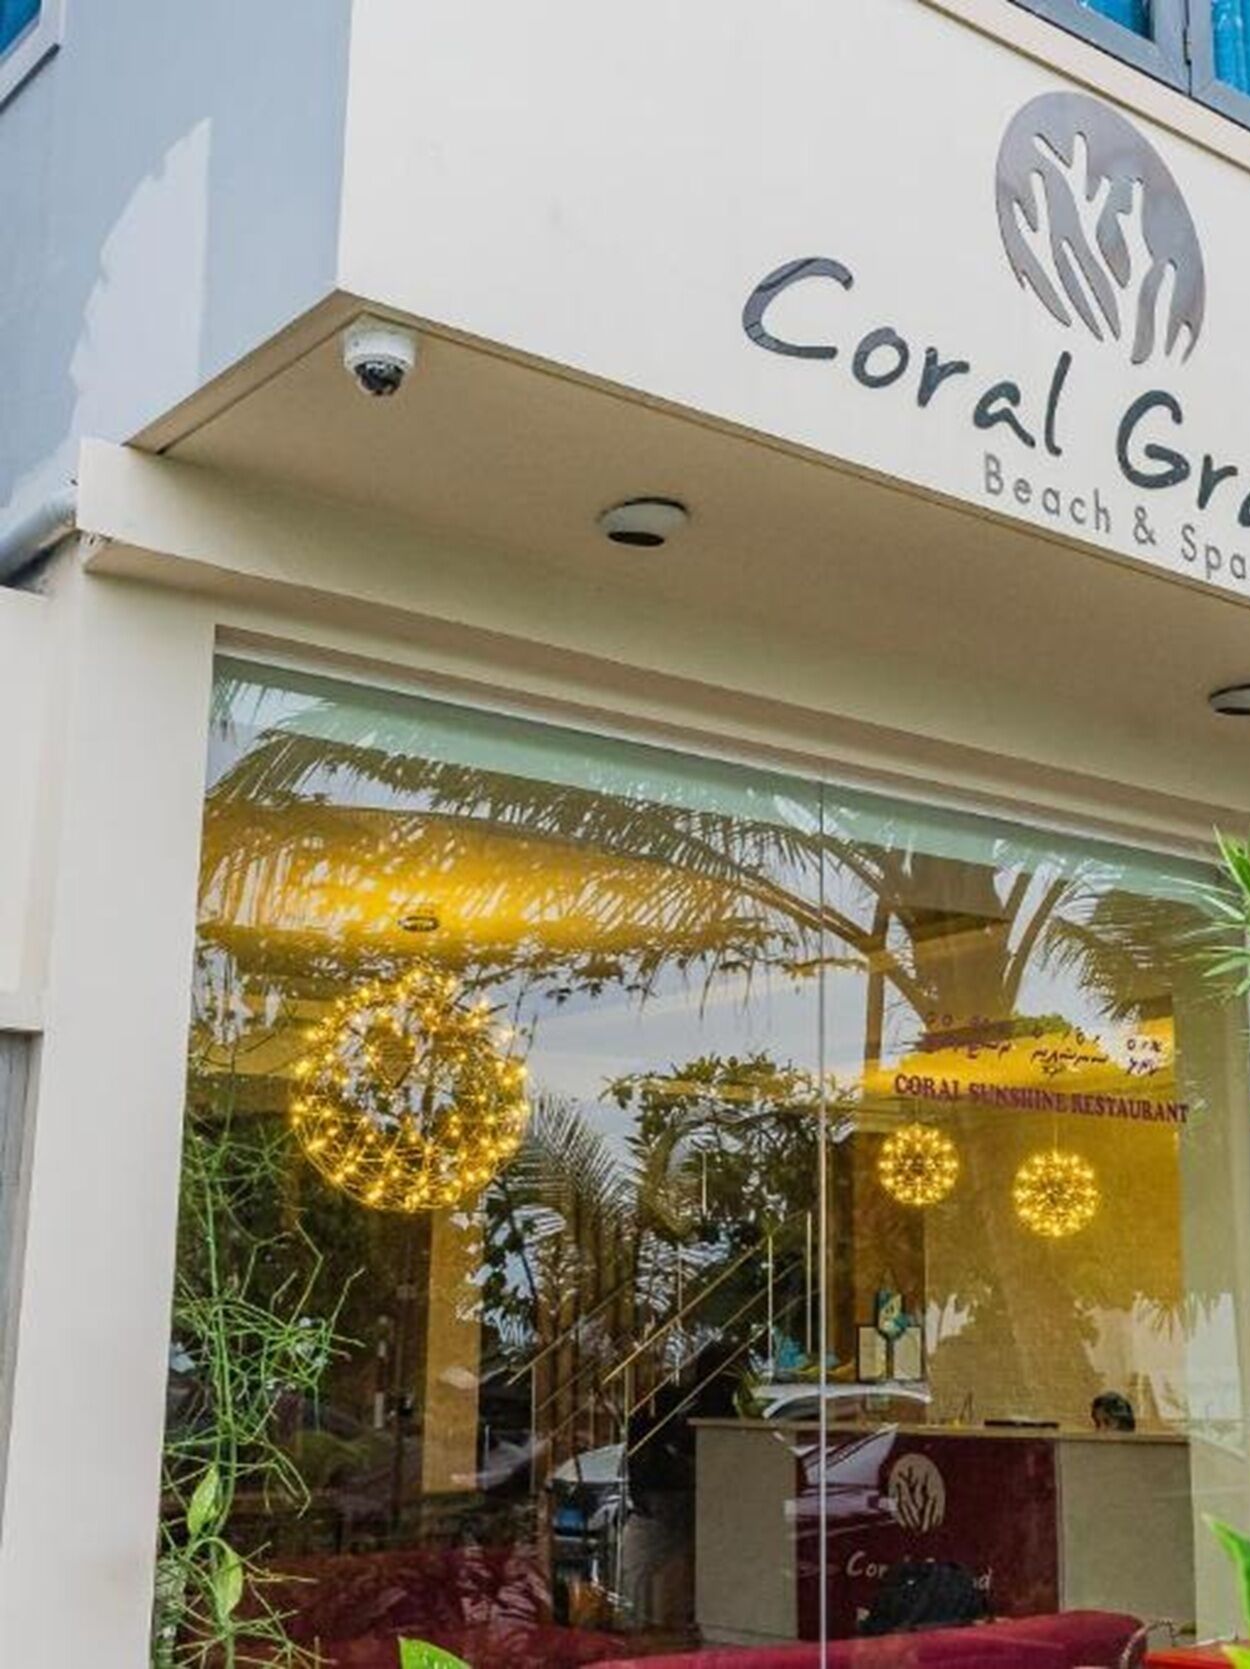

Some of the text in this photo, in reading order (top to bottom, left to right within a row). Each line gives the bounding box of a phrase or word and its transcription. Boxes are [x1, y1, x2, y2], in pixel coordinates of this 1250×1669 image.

[741, 256, 1073, 458] Coral
[985, 453, 1248, 580] Beach & Spa
[968, 1082, 1067, 1113] SUNSHINE
[1071, 1092, 1190, 1123] RESTAURANT
[846, 1551, 911, 1580] Cor
